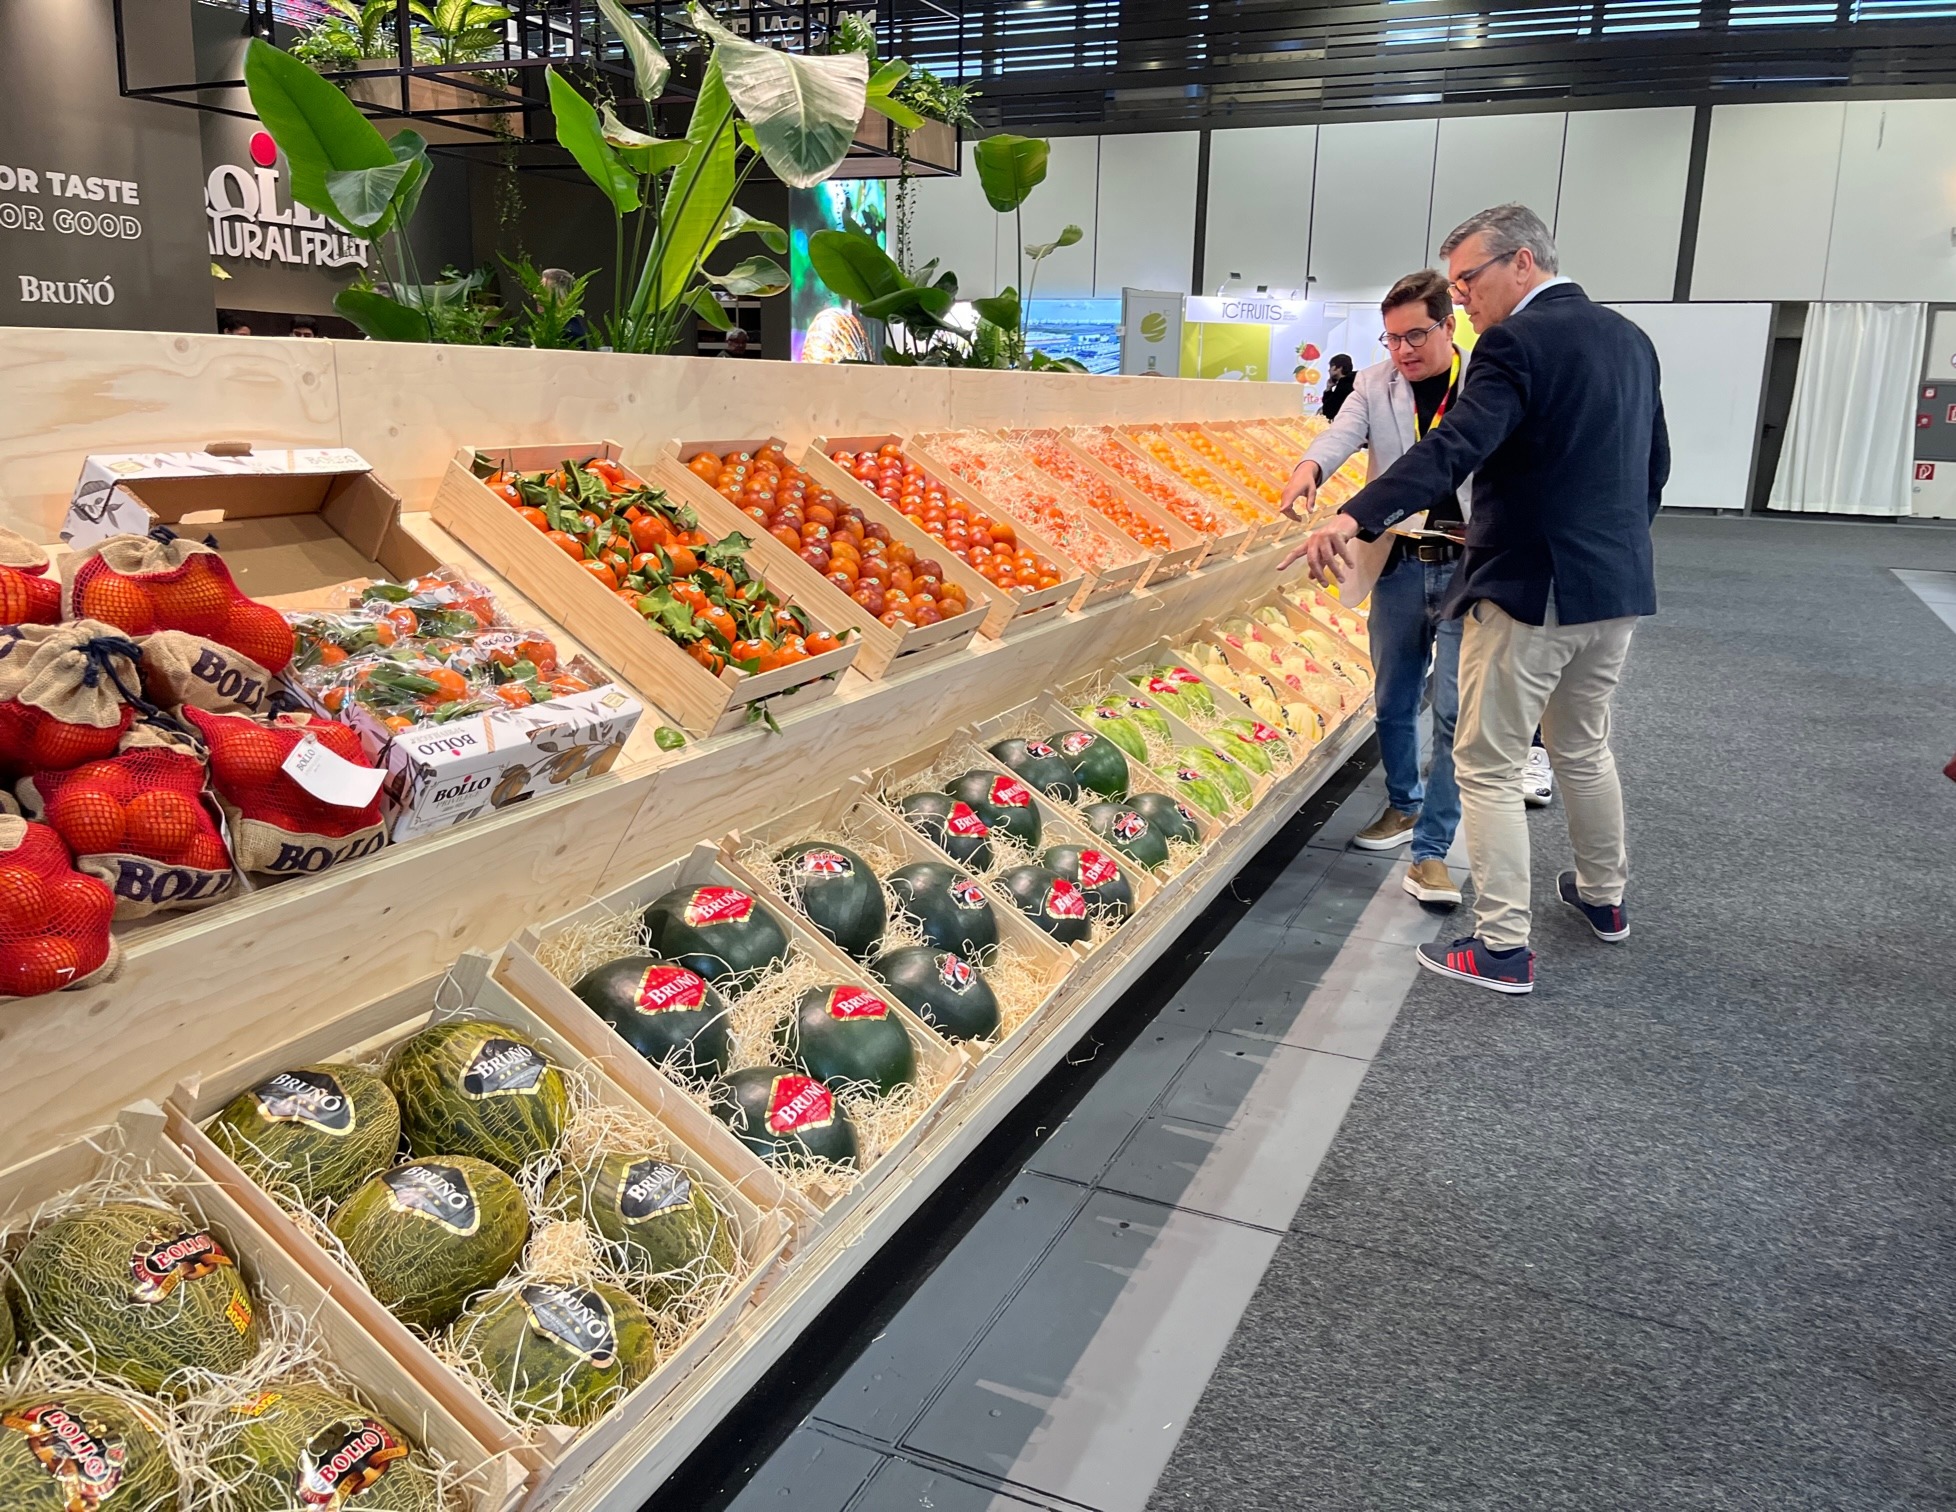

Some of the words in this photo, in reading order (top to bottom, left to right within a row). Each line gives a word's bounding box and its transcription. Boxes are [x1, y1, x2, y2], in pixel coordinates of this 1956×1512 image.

[45, 171, 140, 206] TASTE
[53, 209, 142, 240] GOOD
[18, 274, 115, 306] BRUÑÓ
[296, 749, 316, 772] BOLLO
[418, 733, 479, 756] BOLLO
[432, 776, 492, 803] BOLLO
[472, 1043, 533, 1080] BRUÑÓ
[268, 1073, 342, 1112] BRUÑÓ
[400, 1165, 469, 1210] BRUÑÓ
[626, 1162, 677, 1203] BRUÑÓ
[151, 1234, 211, 1271] BOLLO
[225, 1305, 248, 1336] 2025
[44, 1410, 105, 1478] BOLLO
[317, 1430, 381, 1485] BOLLO
